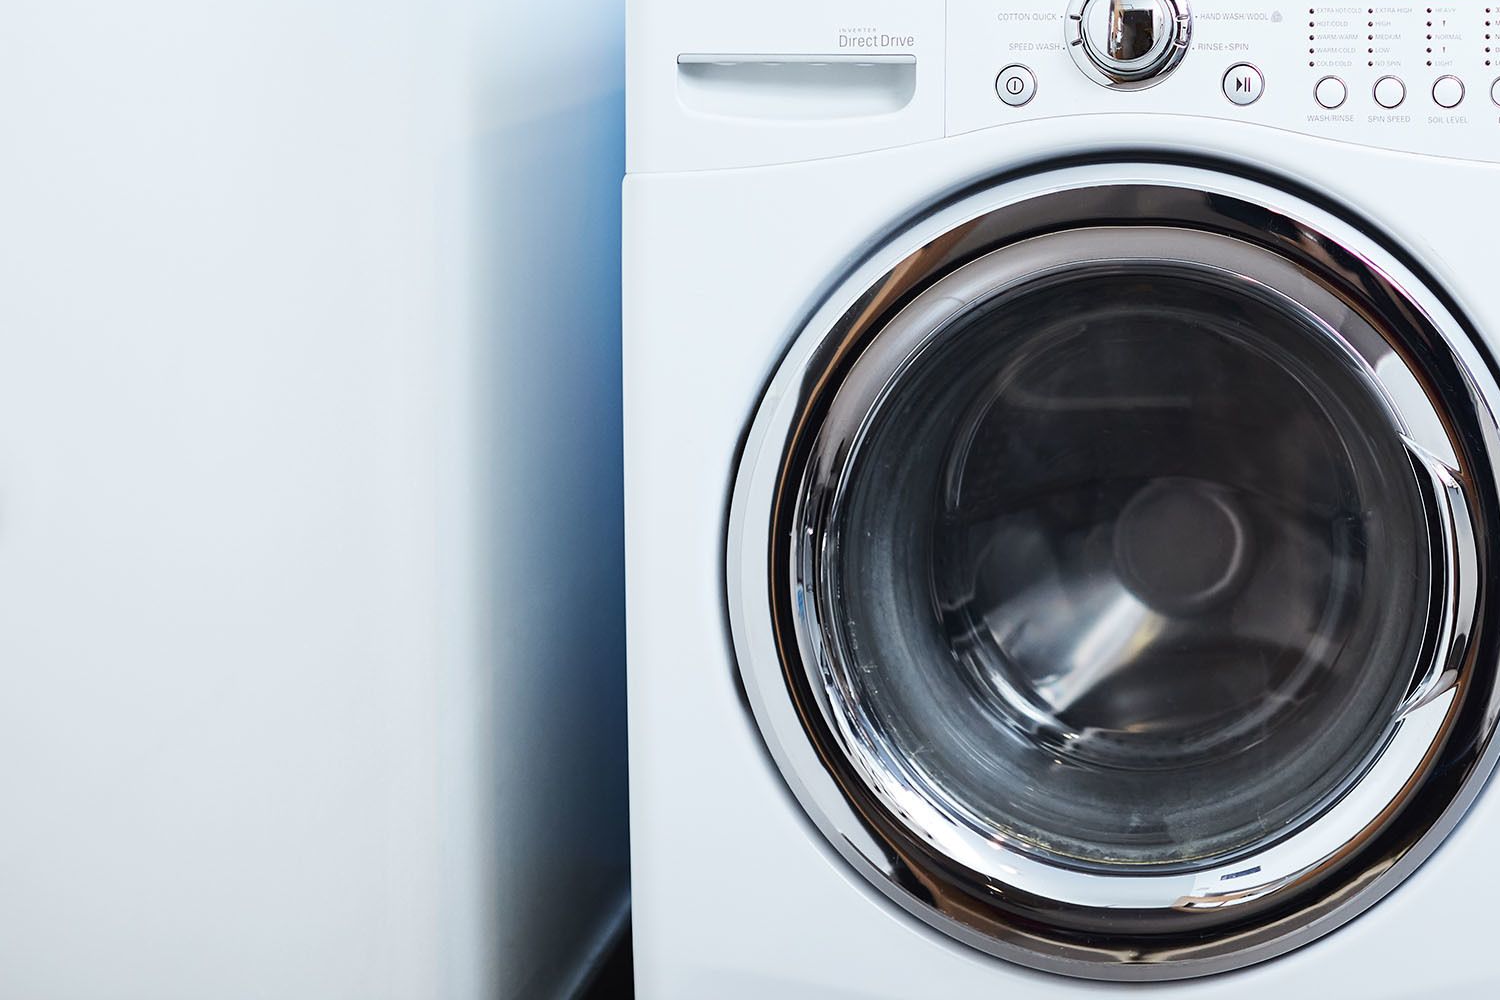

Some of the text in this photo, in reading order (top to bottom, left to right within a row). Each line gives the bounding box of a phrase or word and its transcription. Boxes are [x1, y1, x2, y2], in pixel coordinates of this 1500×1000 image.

[998, 13, 1057, 21] COTTON QUICK
[1200, 13, 1269, 21] HAND WASH/WOOL
[839, 35, 914, 48] Direct Drive
[1009, 43, 1061, 51] SPEED WASH
[1198, 43, 1250, 51] RINSE+SPIN
